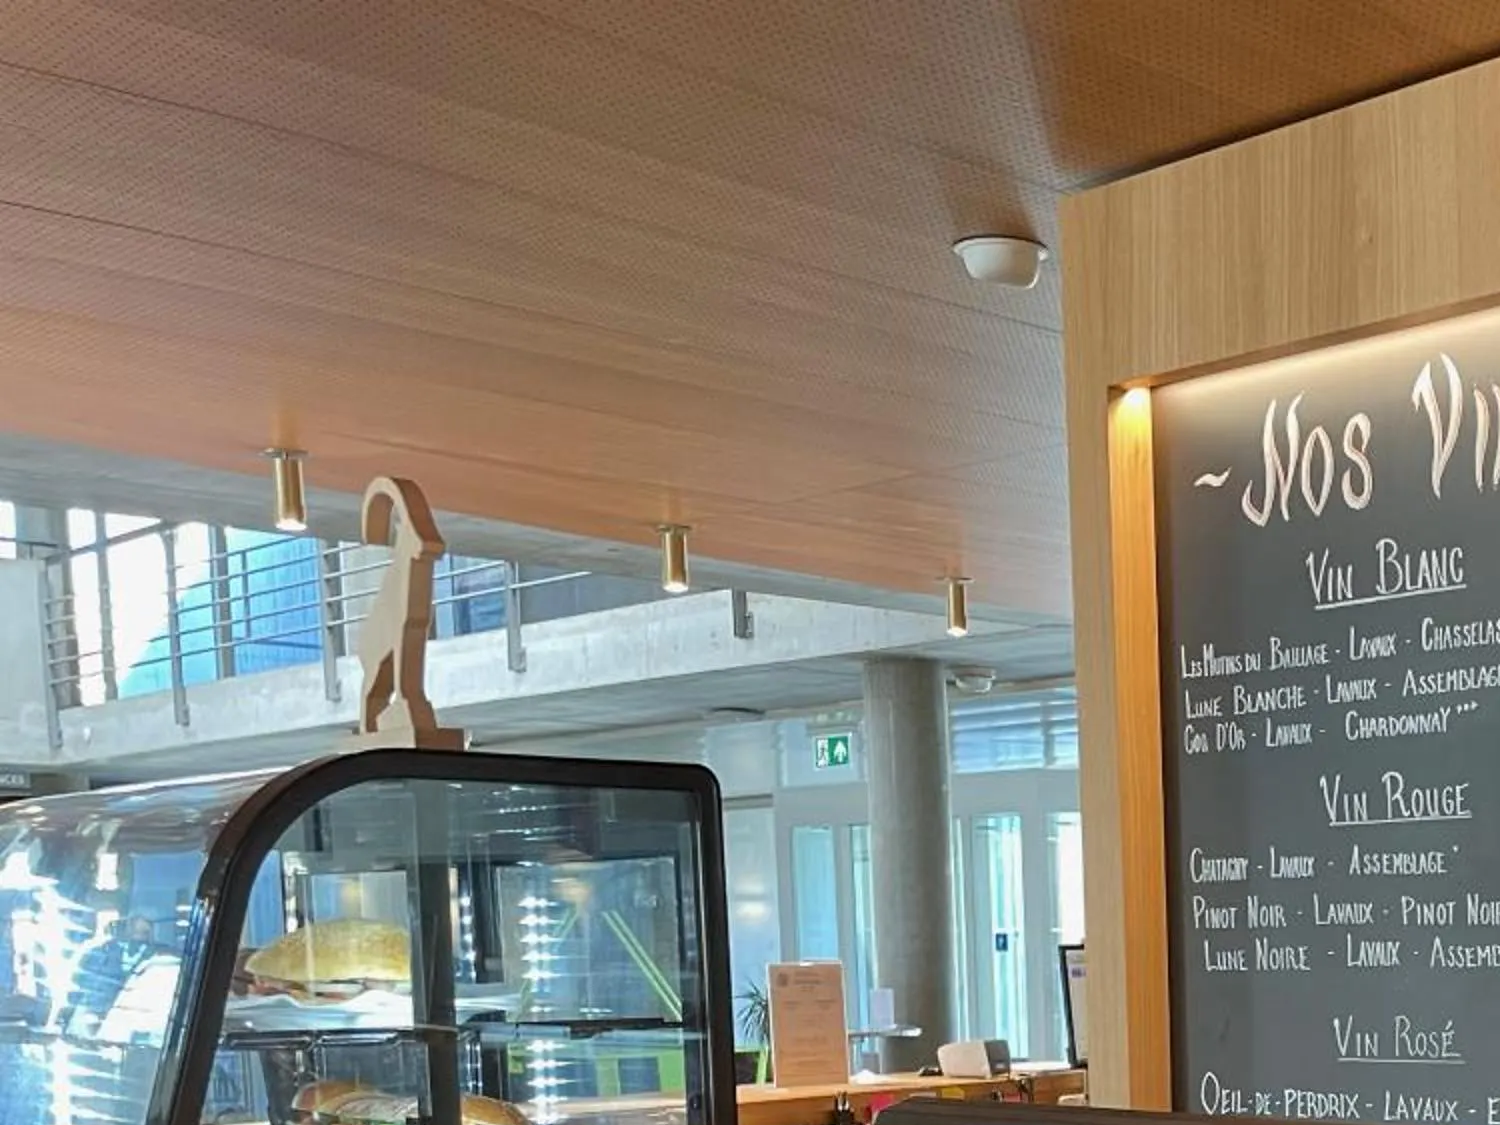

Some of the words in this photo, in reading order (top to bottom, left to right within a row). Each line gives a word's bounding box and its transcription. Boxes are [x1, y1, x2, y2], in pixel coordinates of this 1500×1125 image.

[1242, 389, 1373, 527] NOS
[1306, 549, 1352, 602] VIN
[1376, 537, 1463, 594] BLANC
[1186, 689, 1222, 719] LUNE
[1234, 685, 1307, 715] BLANCHE
[1320, 774, 1367, 821] VIN
[1381, 771, 1471, 818] ROUGE
[1193, 895, 1238, 928] PINOT
[1247, 895, 1287, 928] NOIR
[1313, 892, 1373, 926] LAVAUX
[1401, 896, 1456, 925] PINOT
[1204, 939, 1248, 972] LUNE
[1255, 937, 1310, 971] NOIRE
[1347, 932, 1400, 967] LAVAUX
[1333, 1015, 1378, 1057] VIN
[1395, 1015, 1461, 1058] ROSÉ
[1384, 1090, 1459, 1121] LAVAUX
